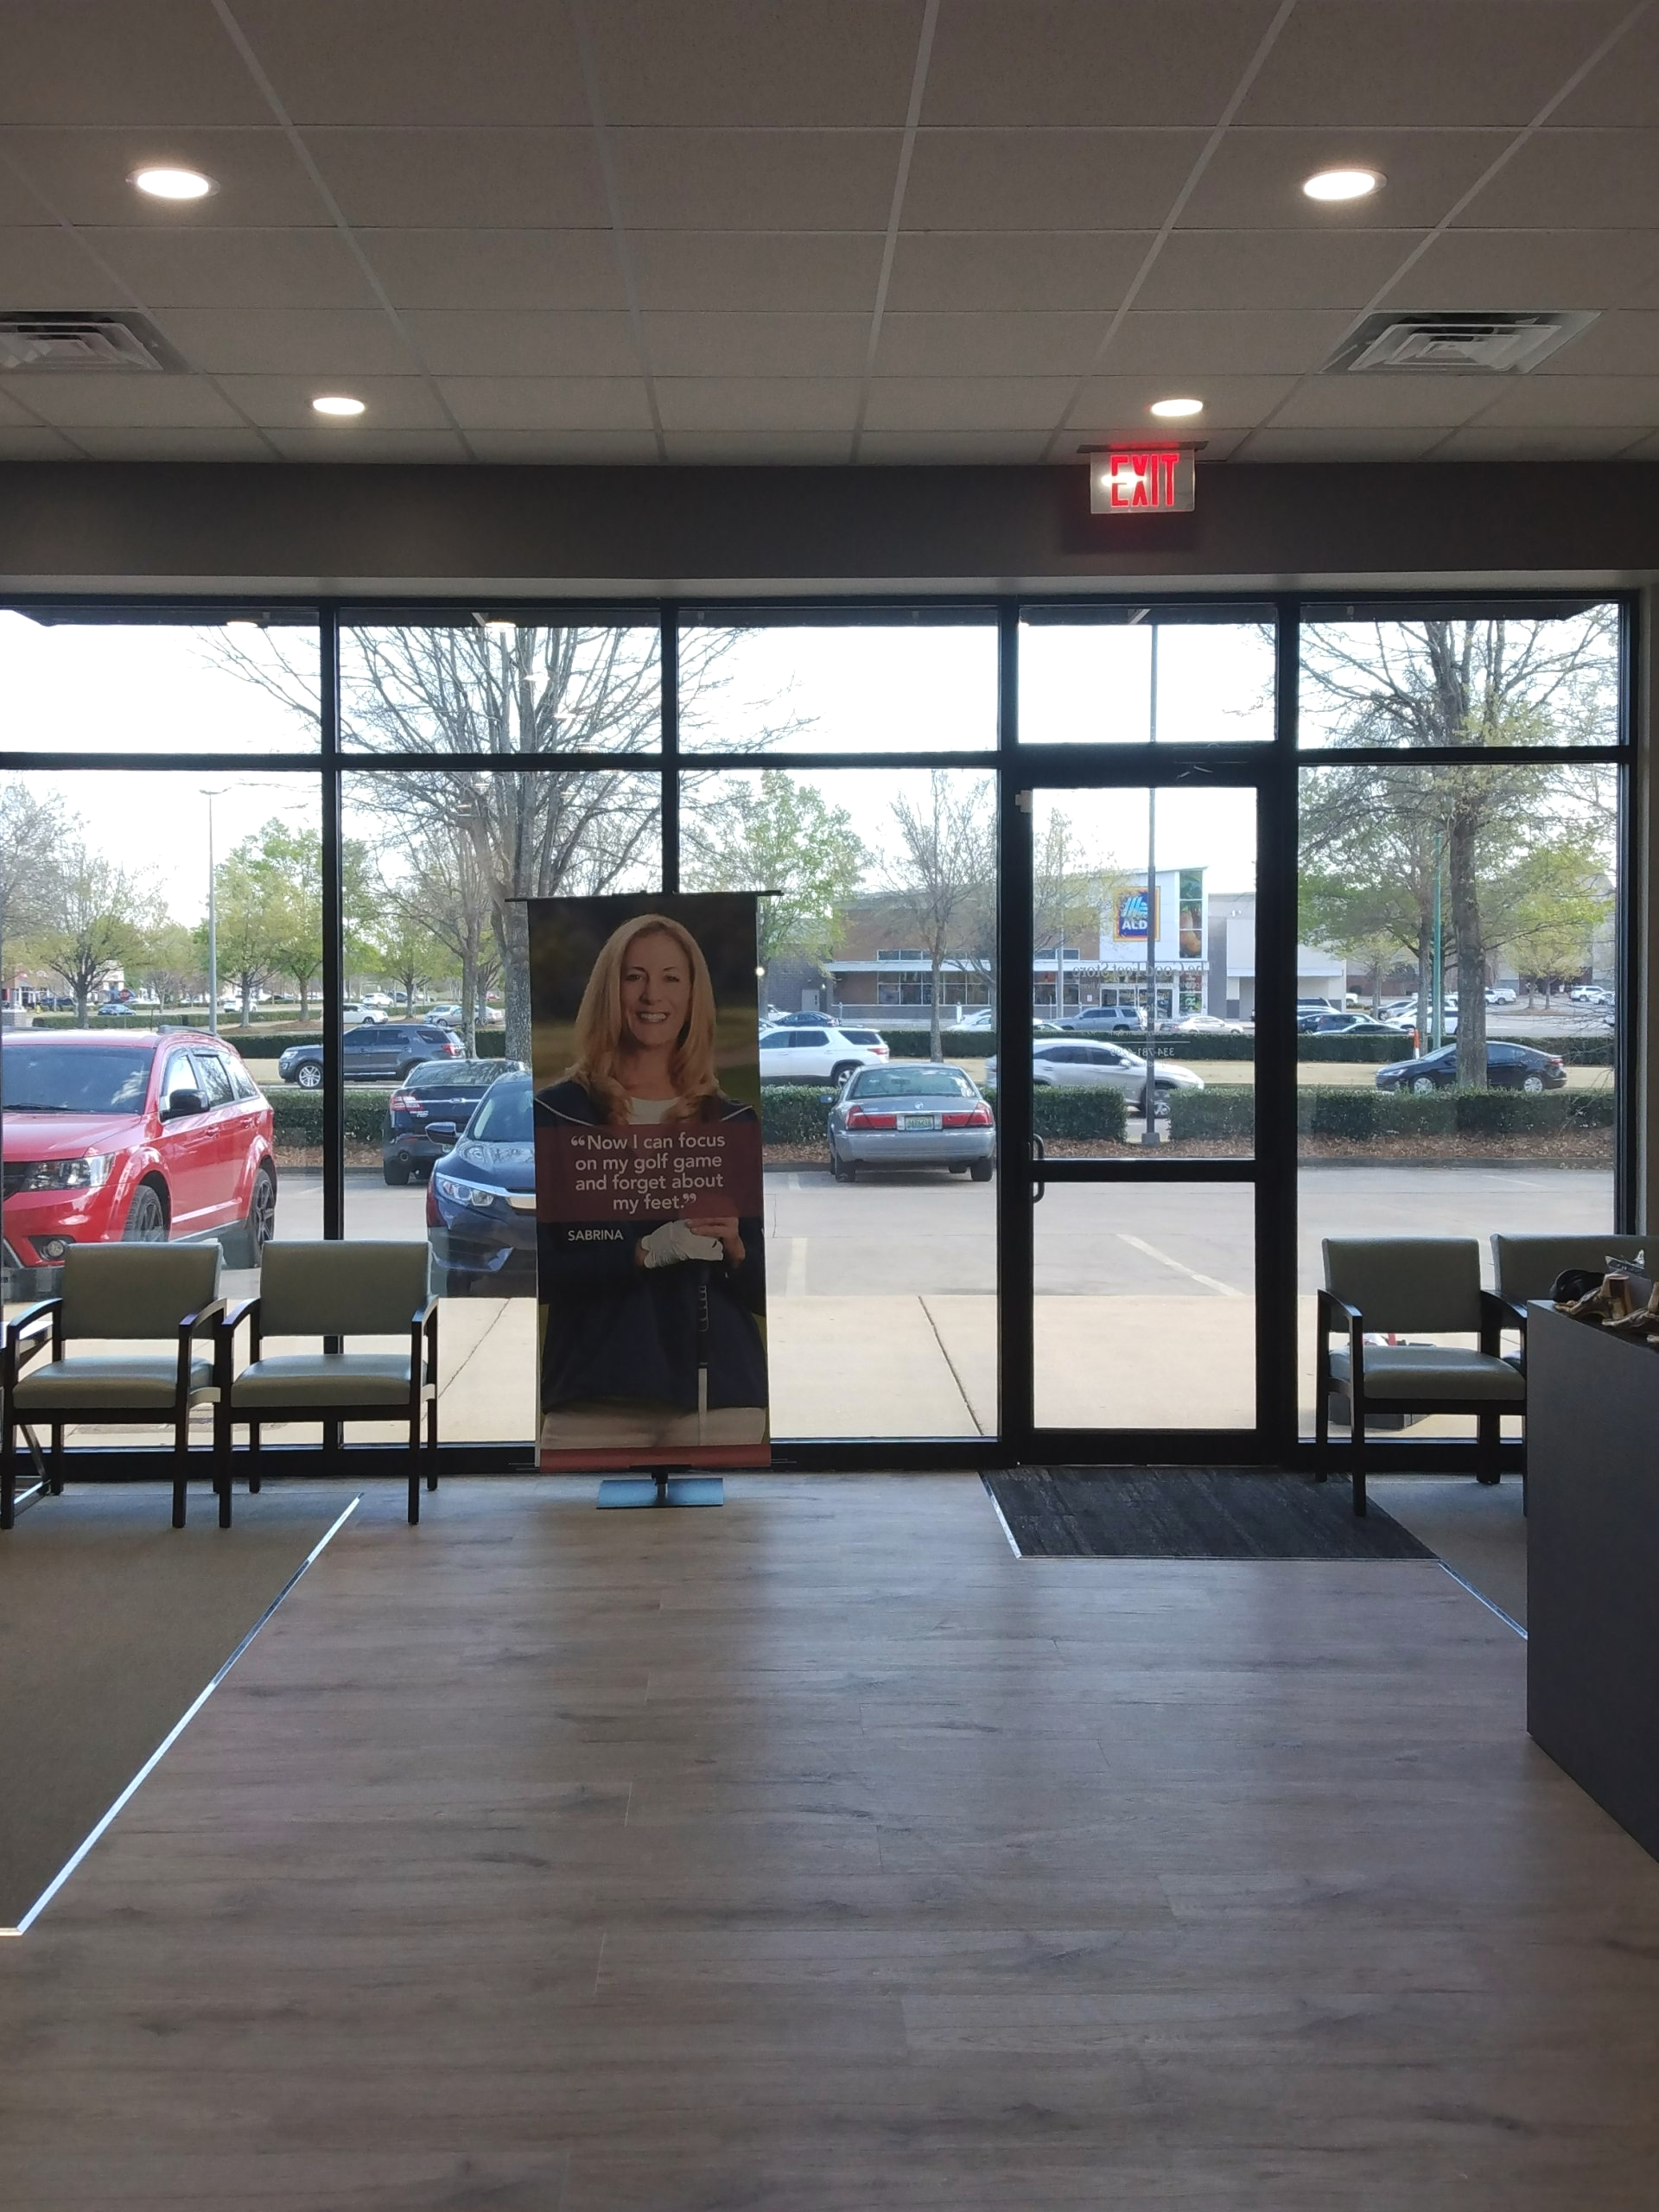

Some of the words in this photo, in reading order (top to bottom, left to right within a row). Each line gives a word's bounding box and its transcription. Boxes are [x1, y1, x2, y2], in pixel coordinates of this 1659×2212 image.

[1110, 453, 1180, 508] EXIT
[1122, 919, 1148, 930] ALD
[633, 1135, 638, 1149] I
[643, 1136, 673, 1149] can
[678, 1132, 726, 1148] focus
[575, 1159, 597, 1172] on
[603, 1158, 629, 1174] my
[634, 1153, 669, 1174] golf
[673, 1155, 722, 1173] game
[575, 1174, 607, 1192] and
[613, 1173, 666, 1194] forget
[671, 1172, 724, 1190] about
[613, 1197, 639, 1214] my
[568, 1229, 624, 1242] SABRINA
